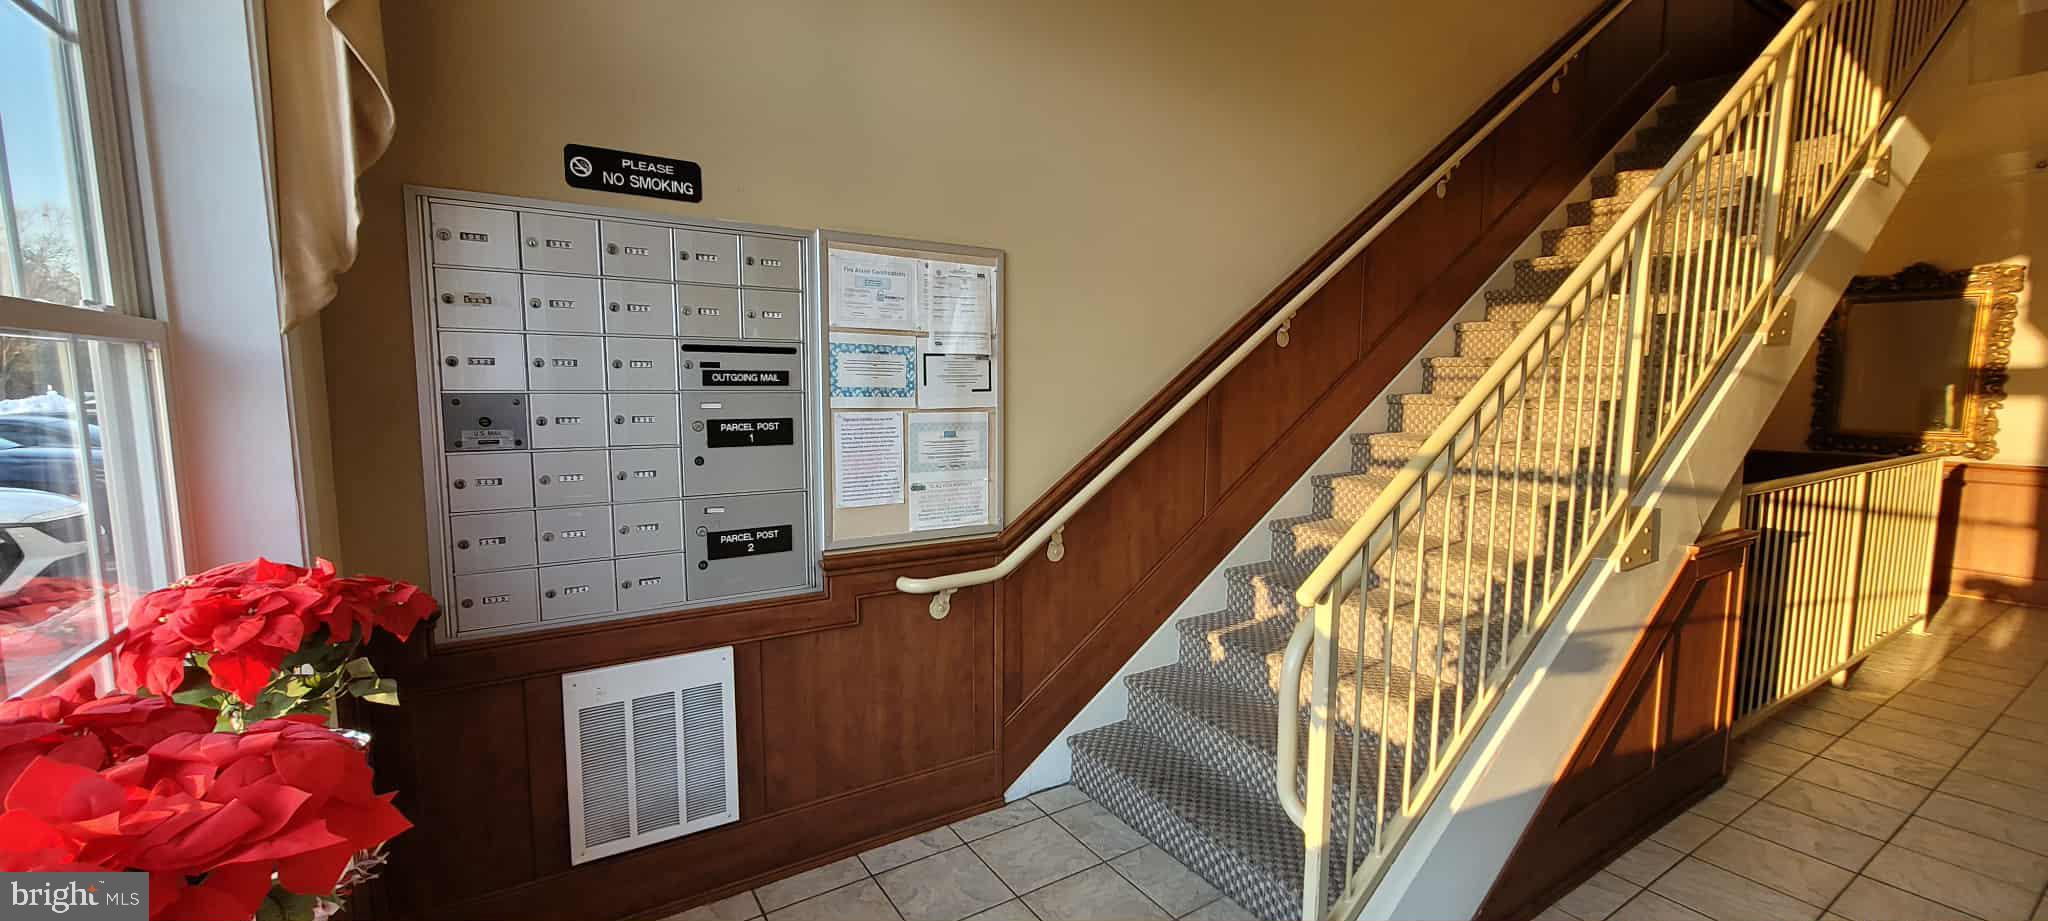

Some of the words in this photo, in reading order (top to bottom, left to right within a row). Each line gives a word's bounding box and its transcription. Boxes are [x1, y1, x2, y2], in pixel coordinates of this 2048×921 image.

[622, 158, 674, 175] PLEASE
[602, 171, 625, 186] NO
[630, 175, 694, 195] SMOKING
[712, 373, 757, 382] OUTGOING
[760, 374, 781, 382] MAIL
[721, 423, 755, 432] PARCEL
[757, 422, 780, 431] POST
[749, 434, 755, 443] 1
[721, 533, 755, 544] PARCEL
[757, 529, 780, 540] POST
[747, 544, 755, 552] 2
